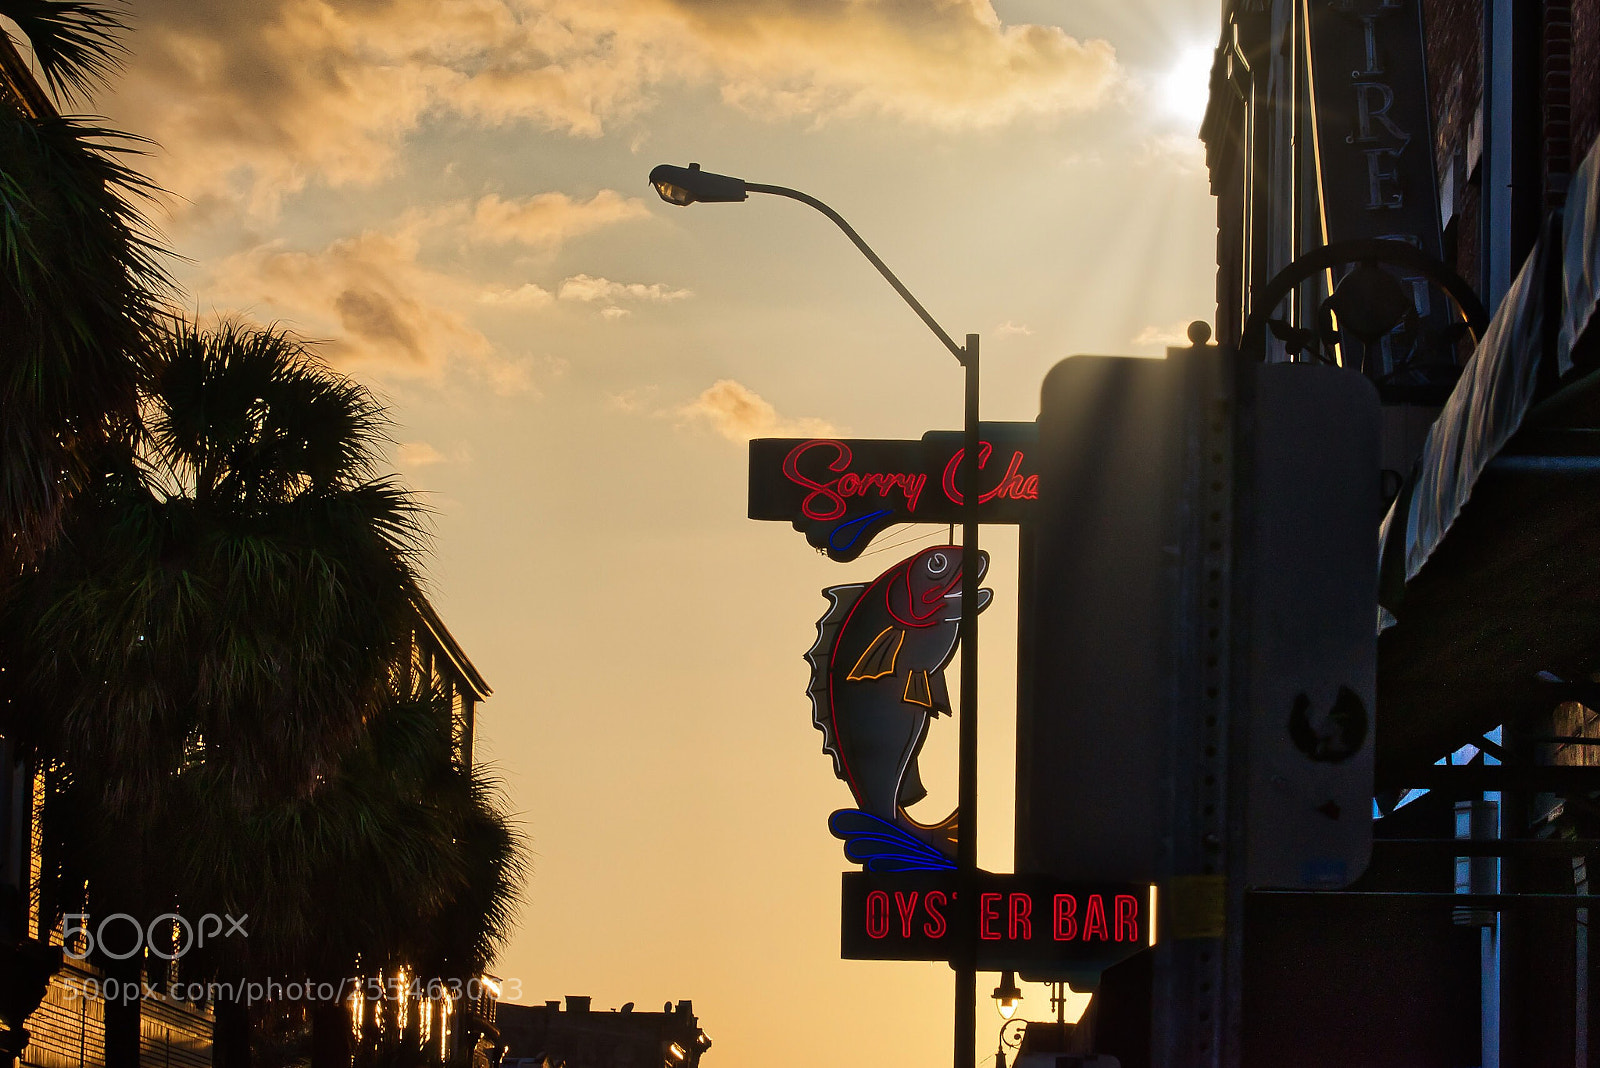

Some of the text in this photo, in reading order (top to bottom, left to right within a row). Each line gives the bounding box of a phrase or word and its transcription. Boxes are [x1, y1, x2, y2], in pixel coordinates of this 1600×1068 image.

[782, 438, 927, 520] Sorry
[866, 890, 1139, 942] OYSER BAR
